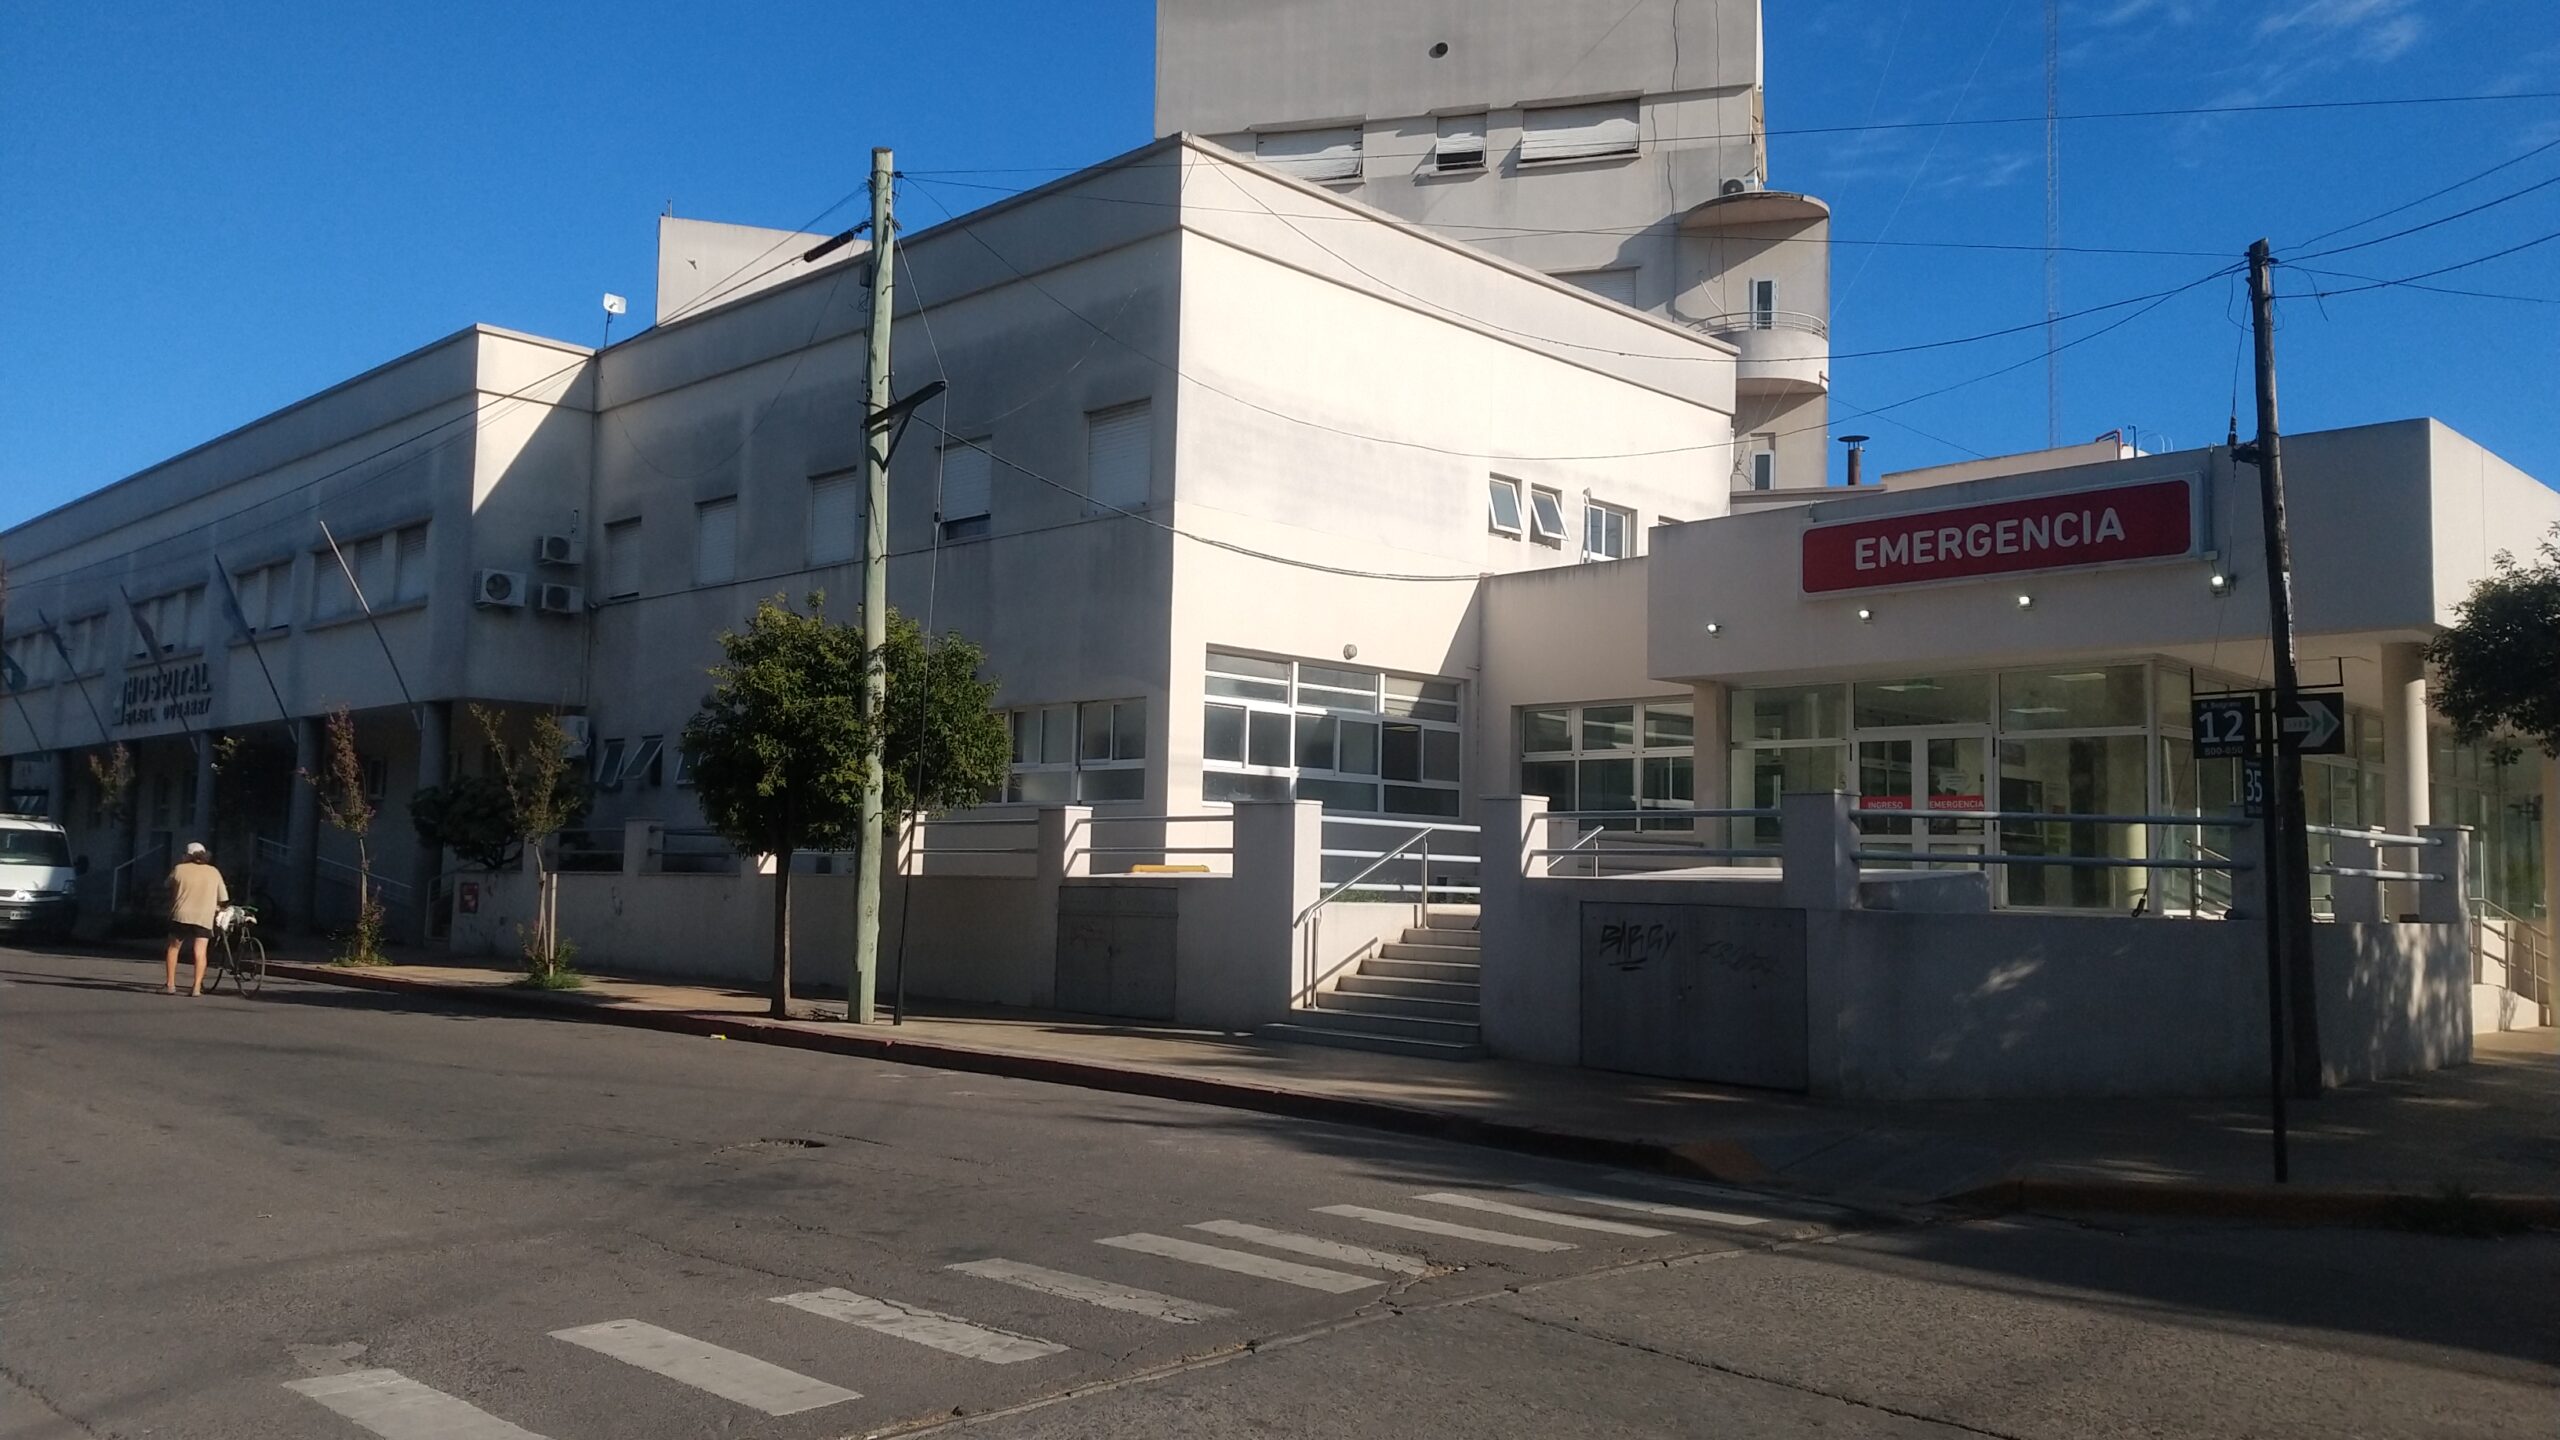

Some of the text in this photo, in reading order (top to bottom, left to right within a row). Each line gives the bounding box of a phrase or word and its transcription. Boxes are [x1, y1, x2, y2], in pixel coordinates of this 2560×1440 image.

[1855, 507, 2126, 571] EMERGENCIA
[127, 663, 212, 704] HOSPITAL
[2199, 710, 2245, 743] 12
[2246, 768, 2263, 802] 35
[1868, 800, 1985, 809] INGRESO EMERGENCIA
